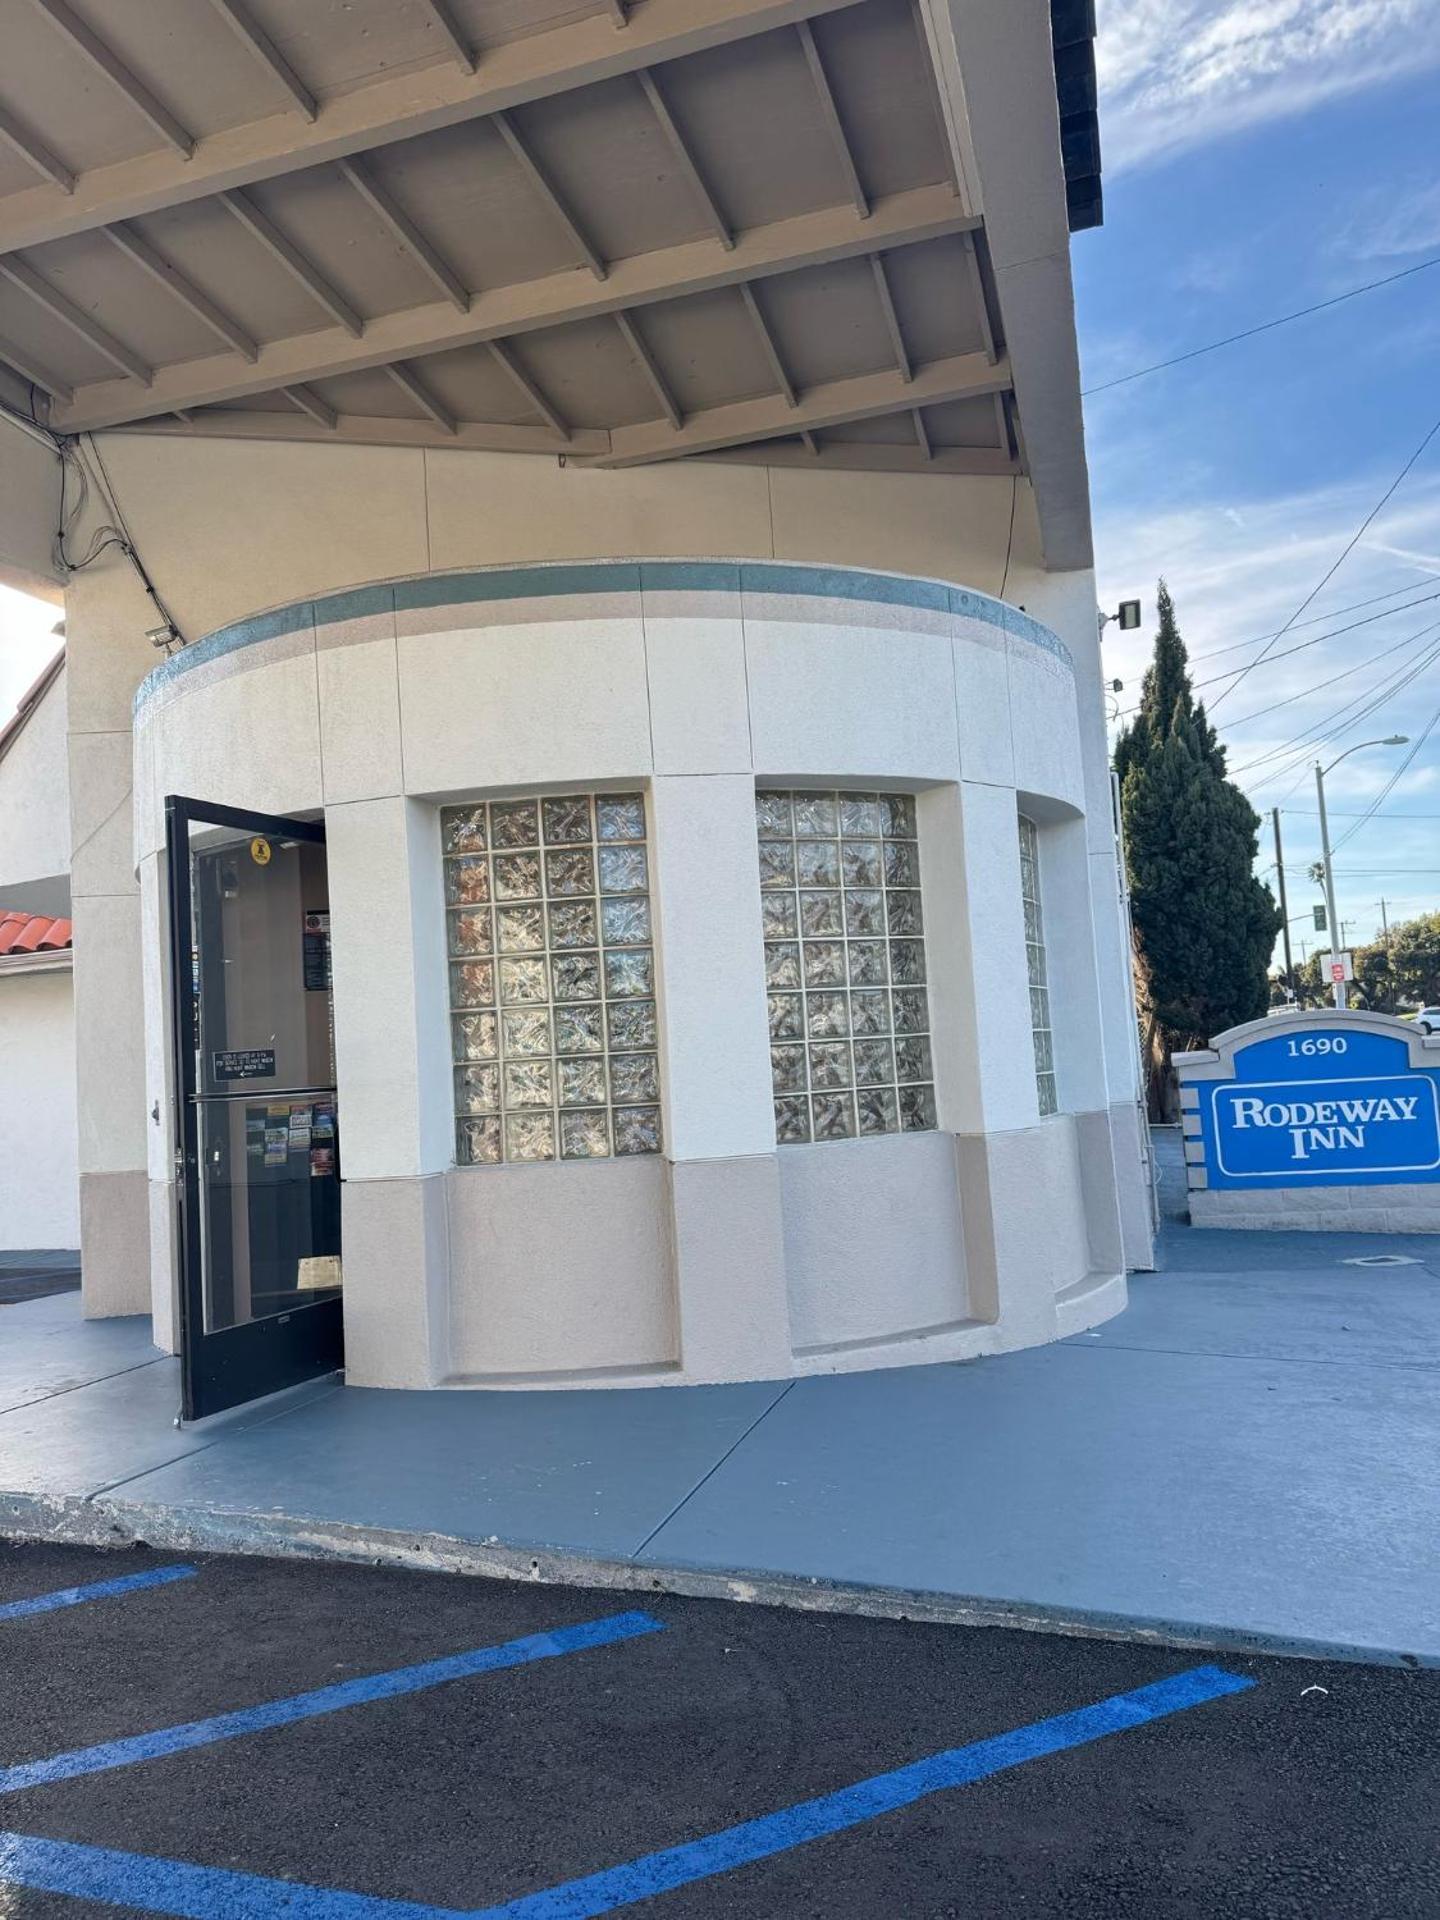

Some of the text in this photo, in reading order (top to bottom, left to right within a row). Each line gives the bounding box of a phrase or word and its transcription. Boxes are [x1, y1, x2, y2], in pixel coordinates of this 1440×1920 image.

[1288, 1037, 1347, 1057] 1690
[1230, 1097, 1418, 1129] RODEWAY
[1289, 1125, 1365, 1159] INN
